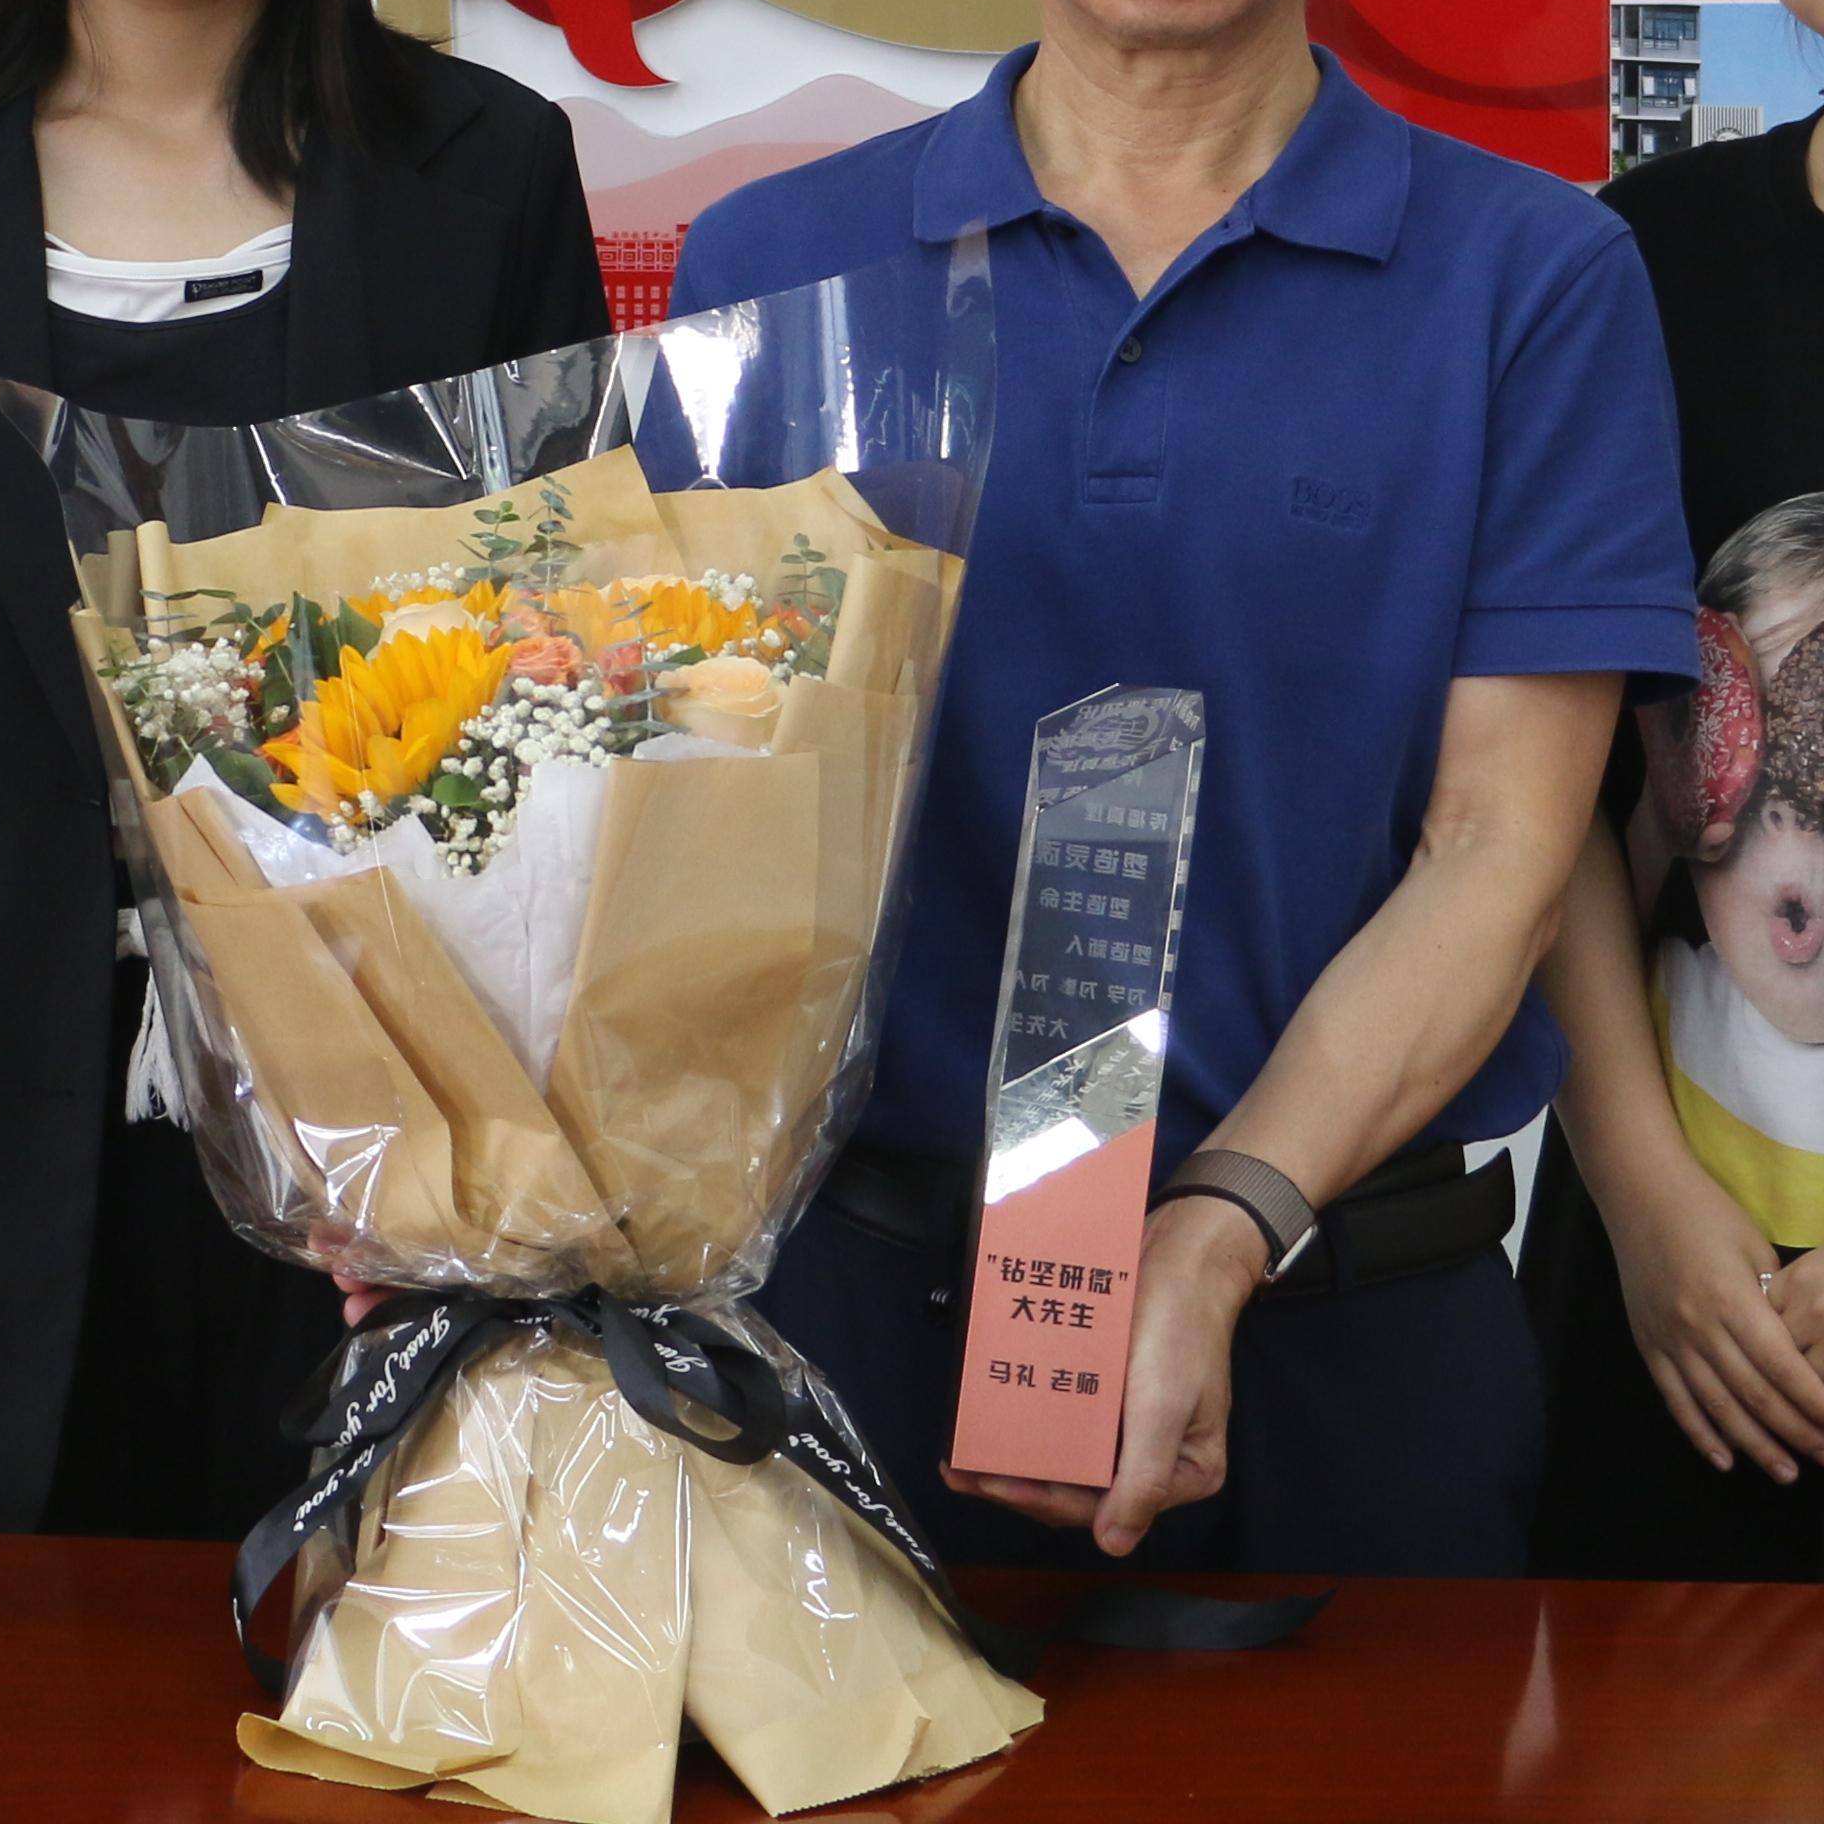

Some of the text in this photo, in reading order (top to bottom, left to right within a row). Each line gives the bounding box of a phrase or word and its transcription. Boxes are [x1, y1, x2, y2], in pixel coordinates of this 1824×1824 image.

[1010, 1295, 1095, 1329] 大先生
[989, 1360, 1100, 1395] 马礼 老师
[799, 1432, 851, 1475] you
